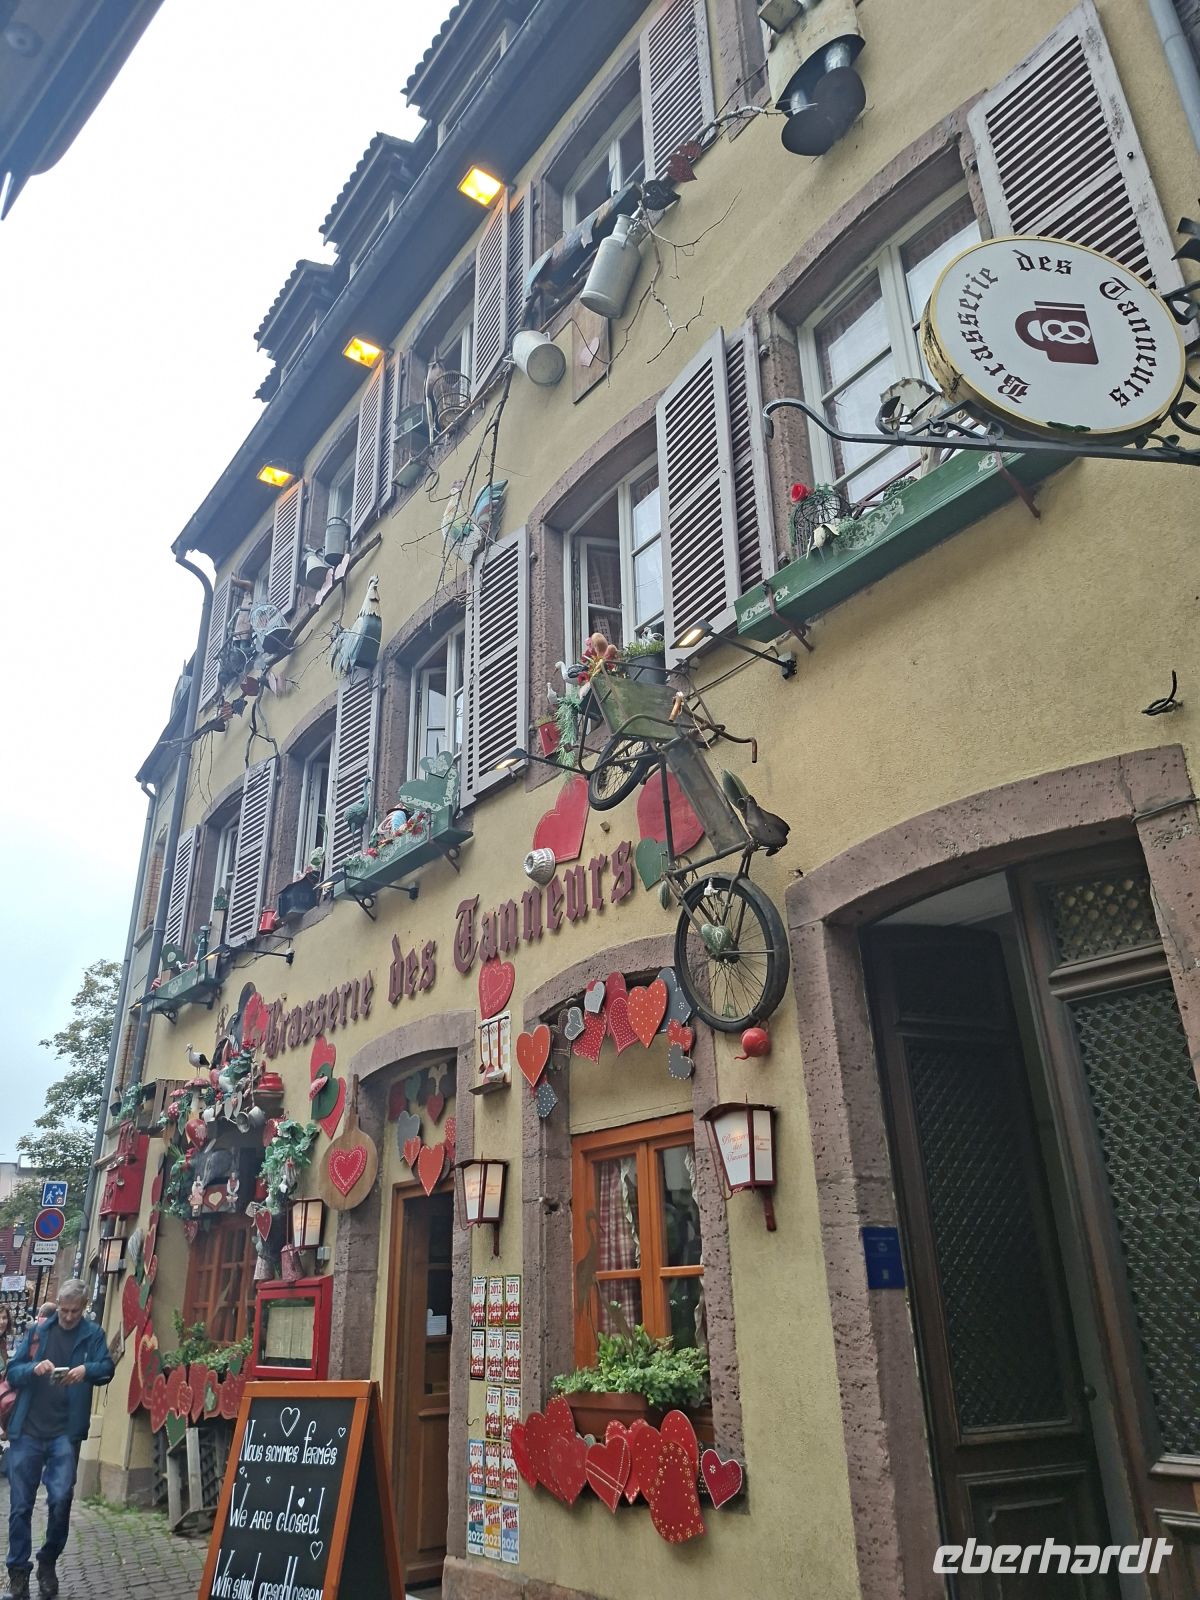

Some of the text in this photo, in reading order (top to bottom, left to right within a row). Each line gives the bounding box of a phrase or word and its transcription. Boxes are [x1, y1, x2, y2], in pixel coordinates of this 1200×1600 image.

[957, 249, 1158, 408] Brasserie des Tanneurs
[387, 933, 436, 1006] des
[453, 840, 634, 975] Tanneurs
[473, 1285, 484, 1295] 2011
[490, 1285, 502, 1294] 2012
[507, 1284, 519, 1293] 2013
[472, 1338, 484, 1348] 2014
[489, 1339, 501, 1348] 2015
[506, 1340, 520, 1350] 2016
[504, 1356, 521, 1369] petit
[488, 1394, 499, 1404] 2017
[505, 1396, 518, 1406] 2018
[470, 1444, 482, 1456] 2019
[485, 1444, 501, 1457] 2020
[502, 1446, 514, 1459] 202
[229, 1483, 251, 1527] We
[275, 1486, 326, 1534] closed
[468, 1501, 483, 1514] petit
[502, 1508, 517, 1521] petit
[468, 1530, 484, 1543] 2022
